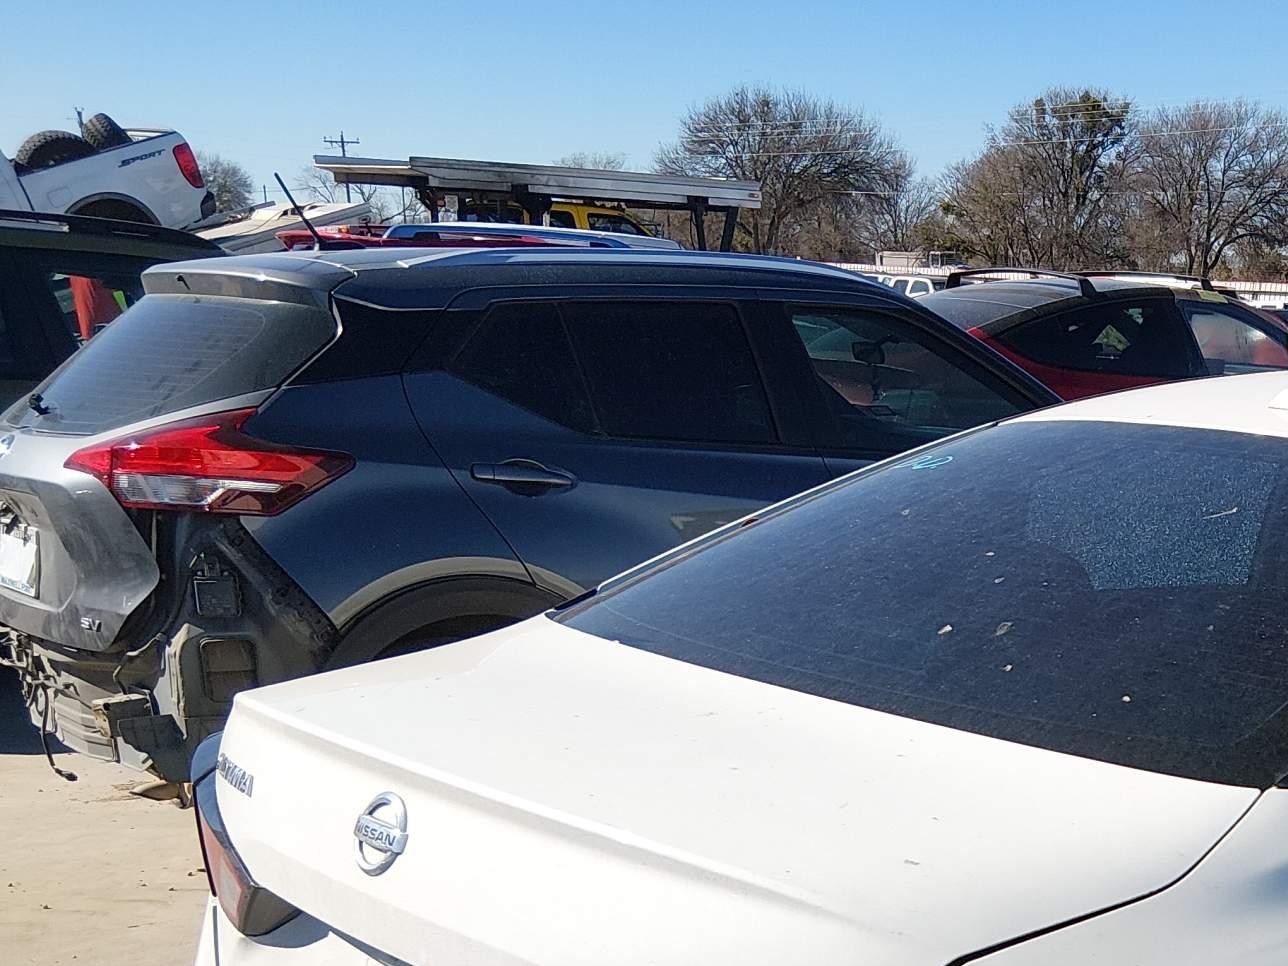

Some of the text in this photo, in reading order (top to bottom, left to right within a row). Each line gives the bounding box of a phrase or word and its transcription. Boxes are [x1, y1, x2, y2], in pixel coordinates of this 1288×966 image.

[118, 149, 166, 168] SPORT
[80, 617, 102, 632] SV
[357, 822, 397, 847] NISSAN
